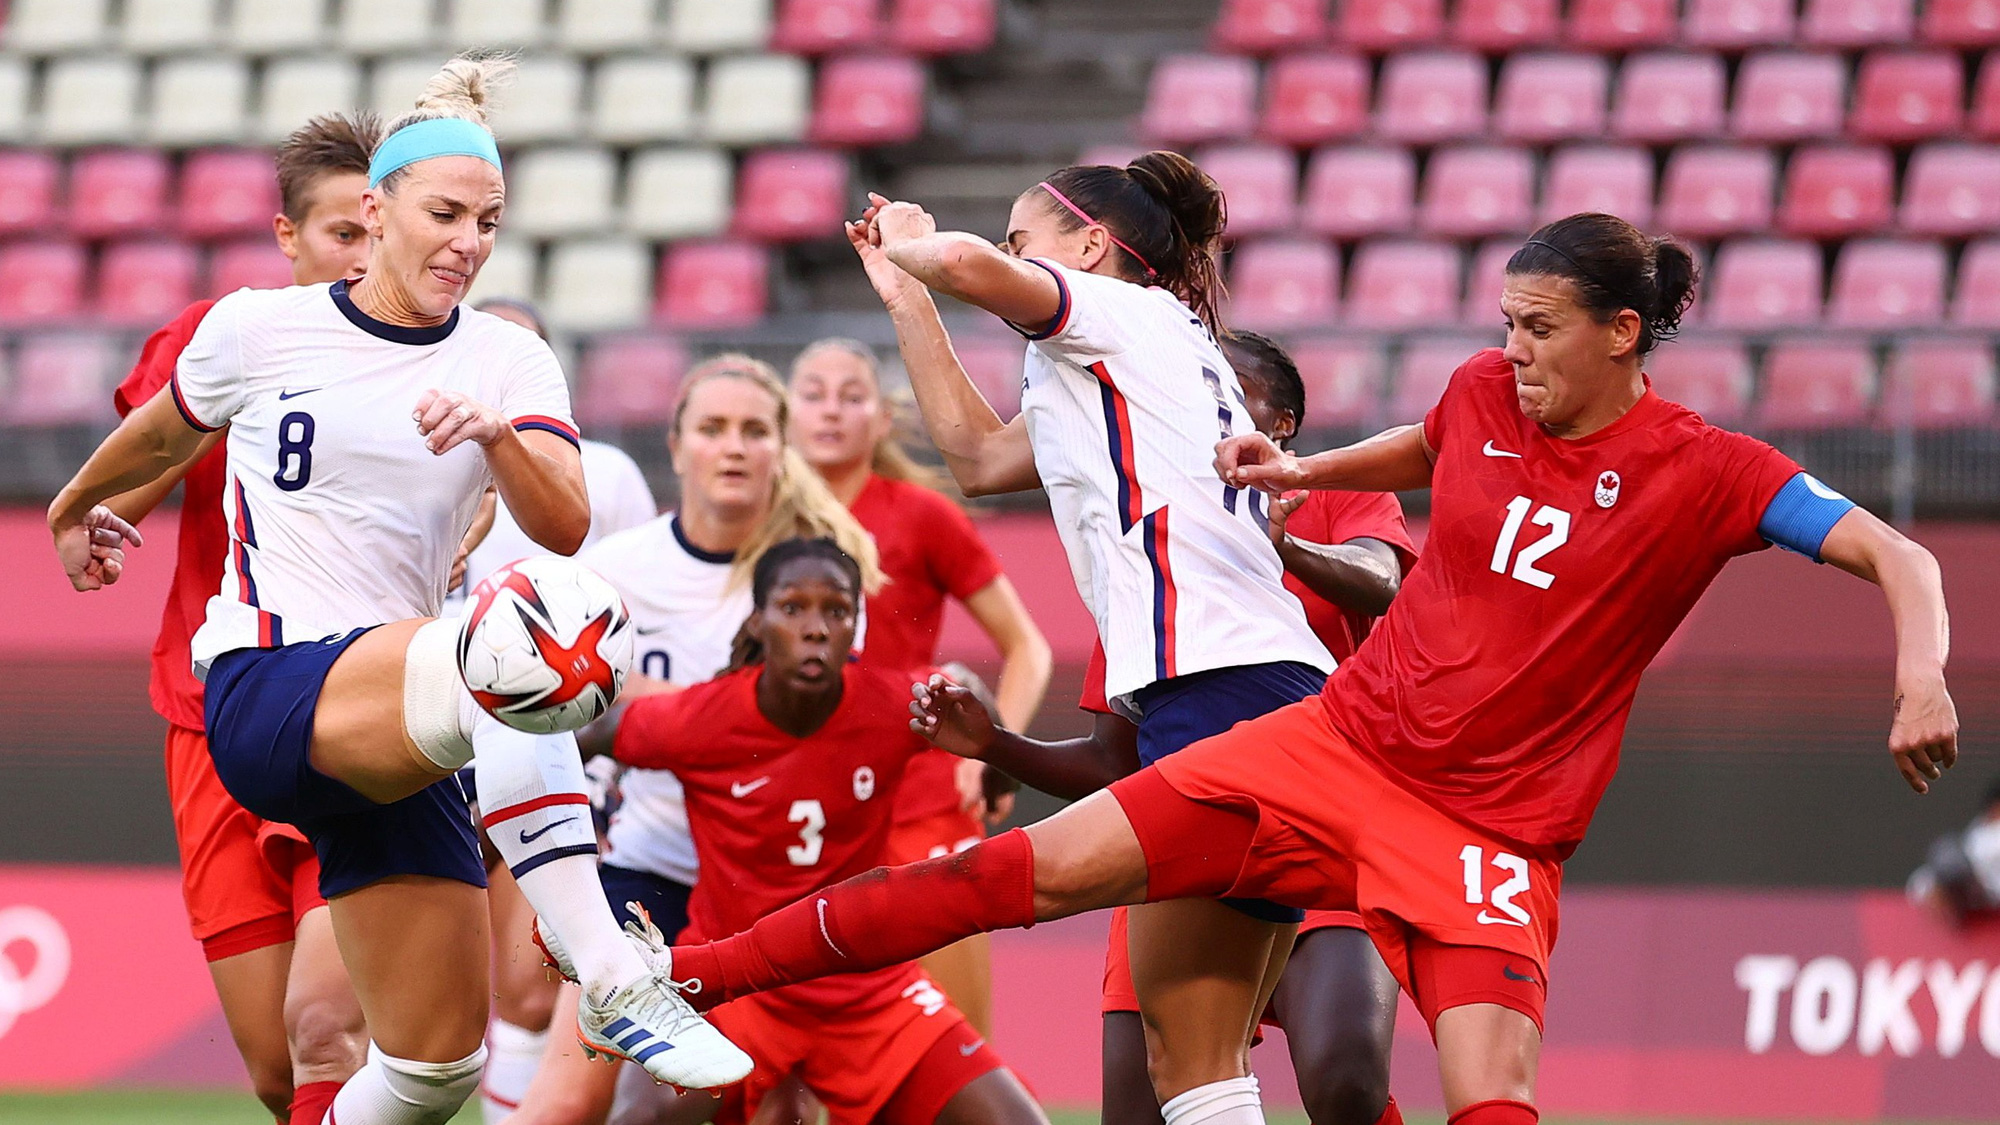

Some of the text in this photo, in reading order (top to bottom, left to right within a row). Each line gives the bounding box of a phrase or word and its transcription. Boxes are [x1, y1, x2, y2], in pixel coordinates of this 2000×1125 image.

[273, 411, 315, 492] 8
[1489, 495, 1572, 590] 12
[786, 799, 826, 866] 3
[1459, 844, 1531, 926] 12
